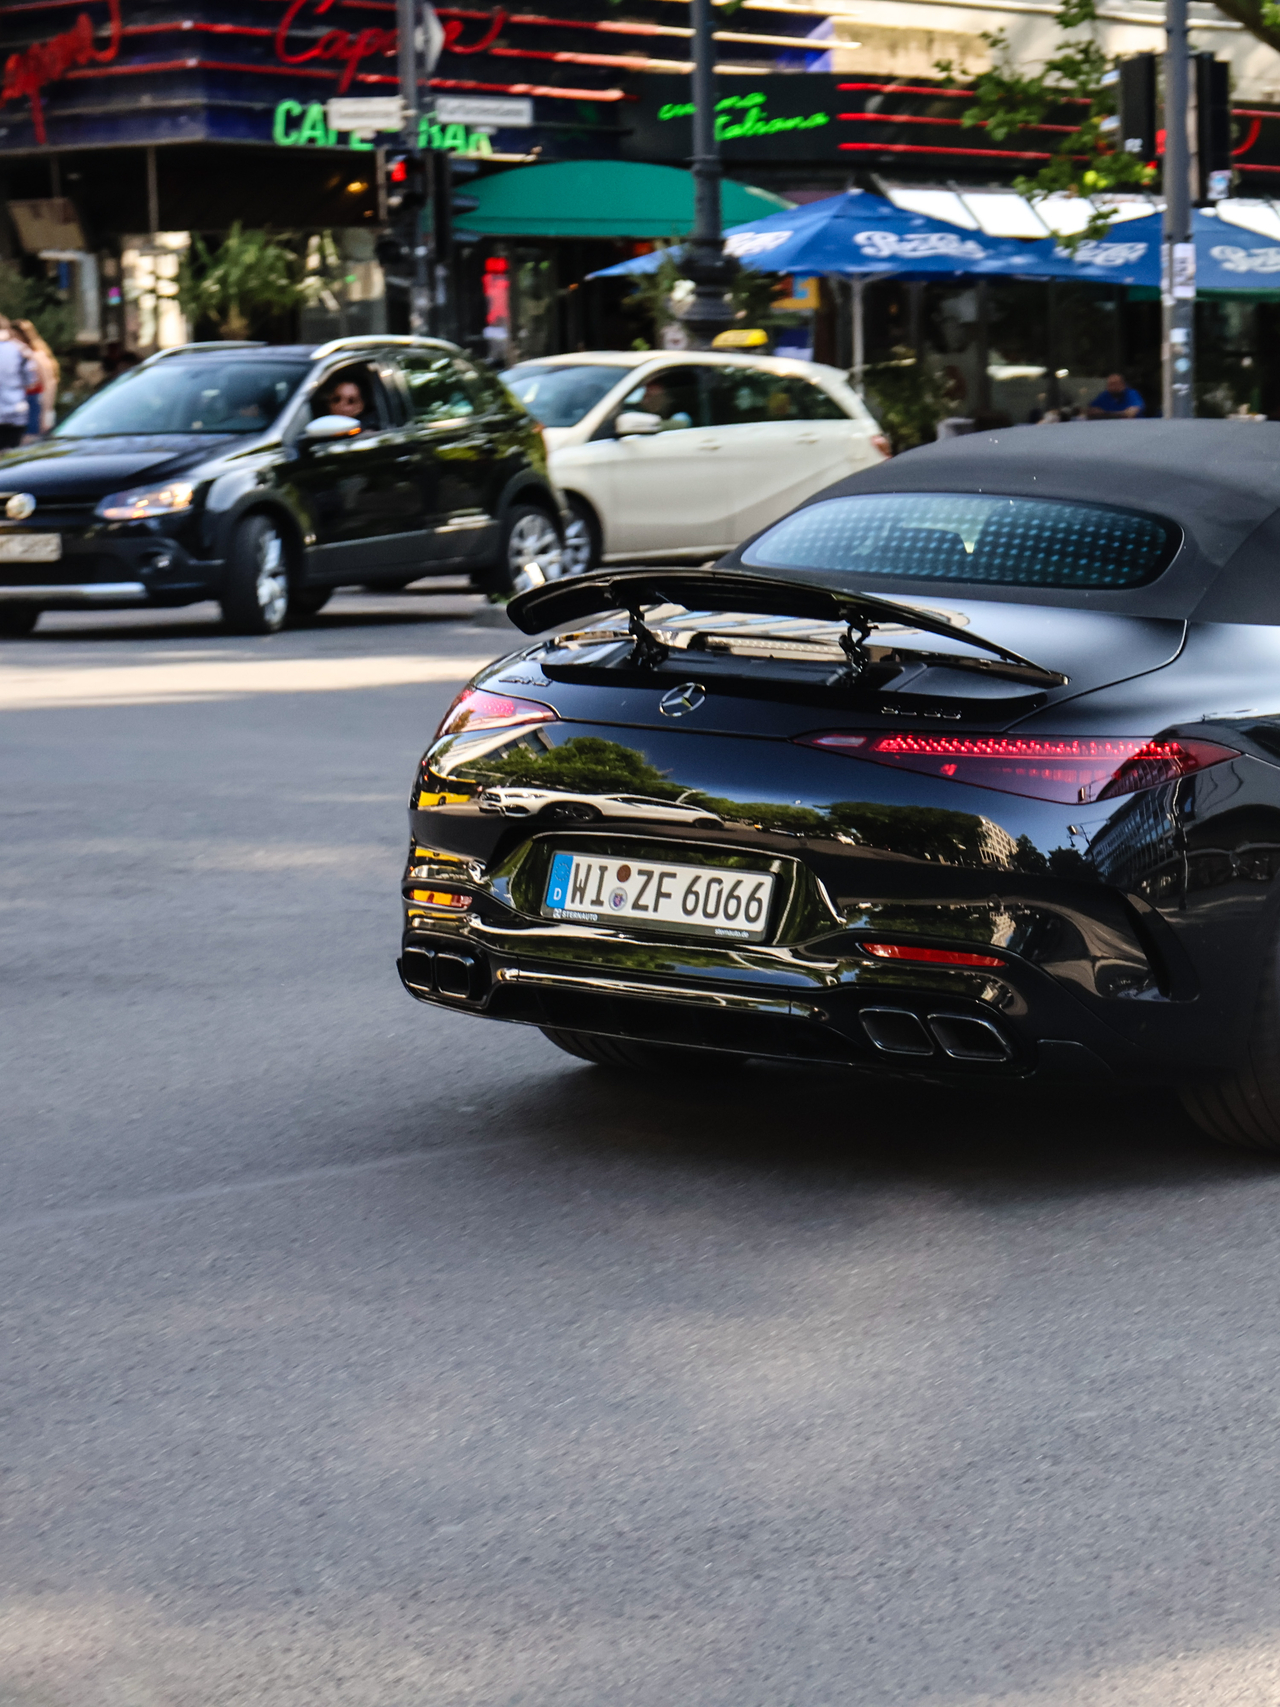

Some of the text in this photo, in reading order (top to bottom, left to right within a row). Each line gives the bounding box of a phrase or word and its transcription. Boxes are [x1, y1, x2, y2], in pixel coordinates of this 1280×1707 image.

[553, 887, 562, 900] D
[570, 863, 765, 923] WI ZF 6066
[561, 909, 598, 921] STERNAUTO
